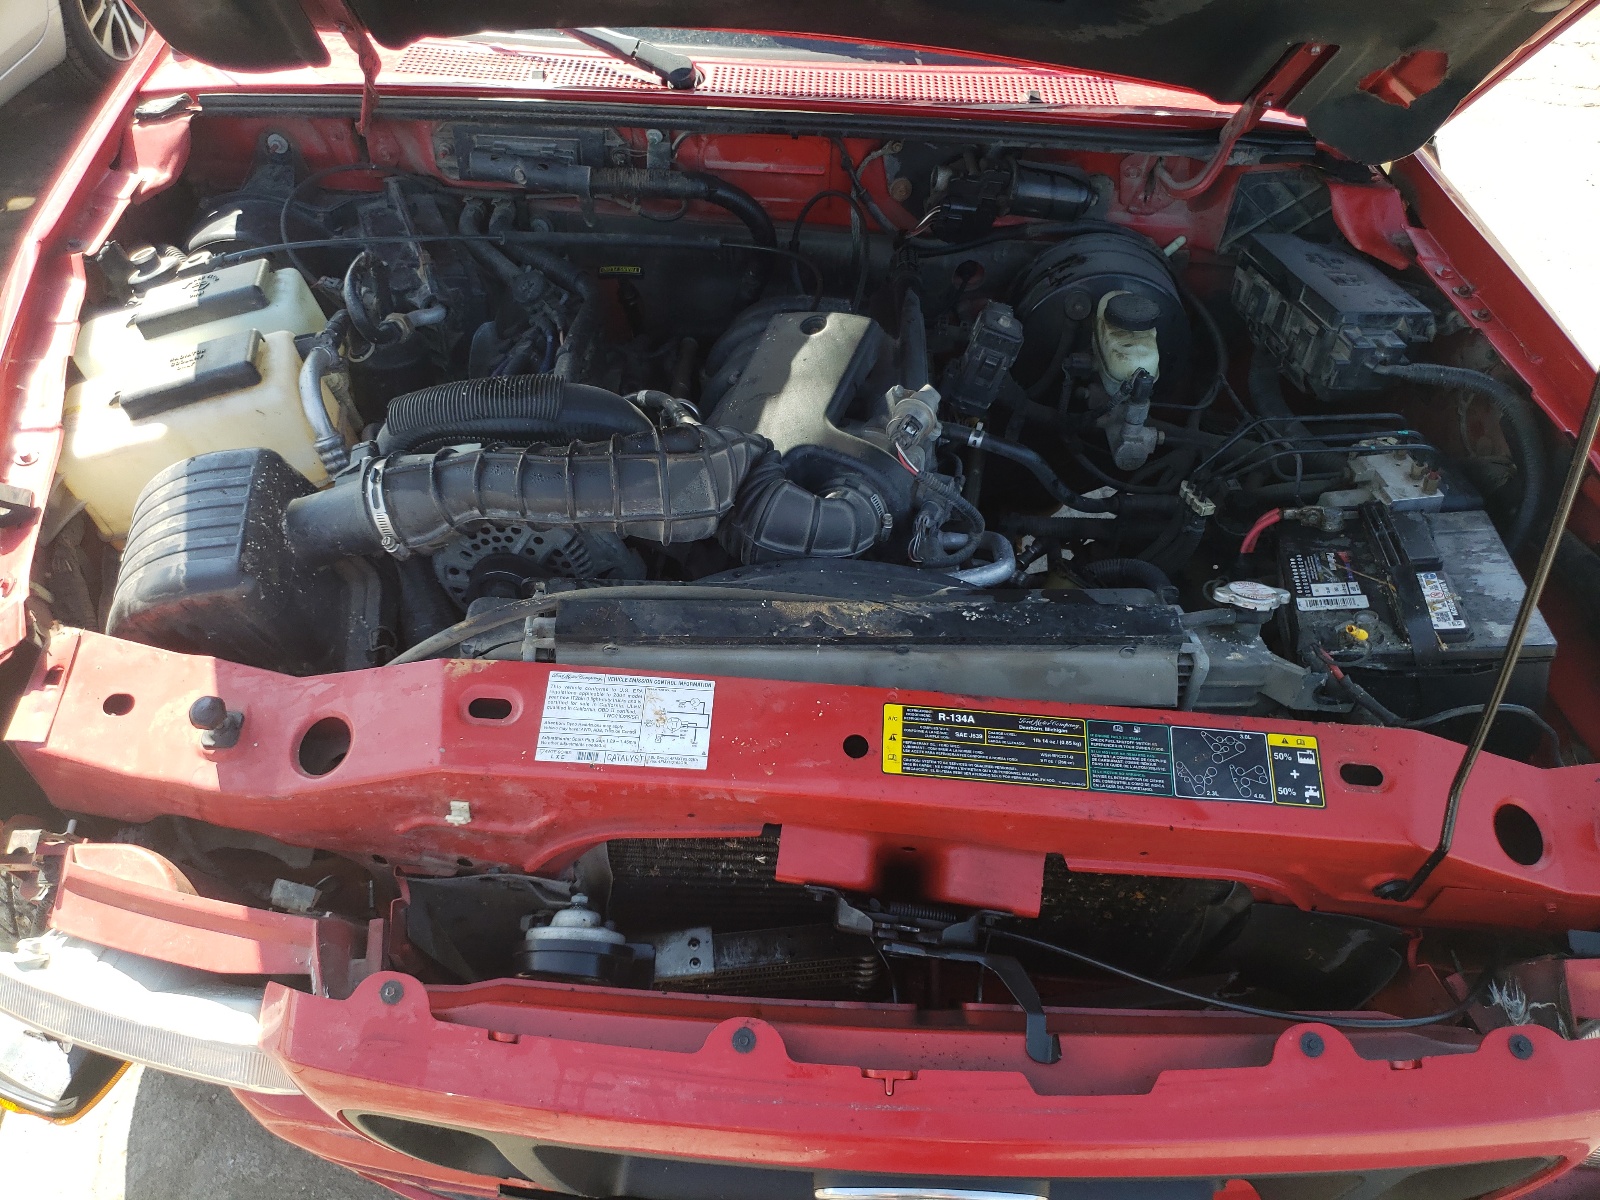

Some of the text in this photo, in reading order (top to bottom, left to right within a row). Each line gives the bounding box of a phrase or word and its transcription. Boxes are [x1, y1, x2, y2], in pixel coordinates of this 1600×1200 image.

[938, 712, 974, 723] R-134A
[606, 754, 644, 763] CATALYST
[1273, 752, 1292, 761] 50%
[1278, 787, 1296, 796] 50%
